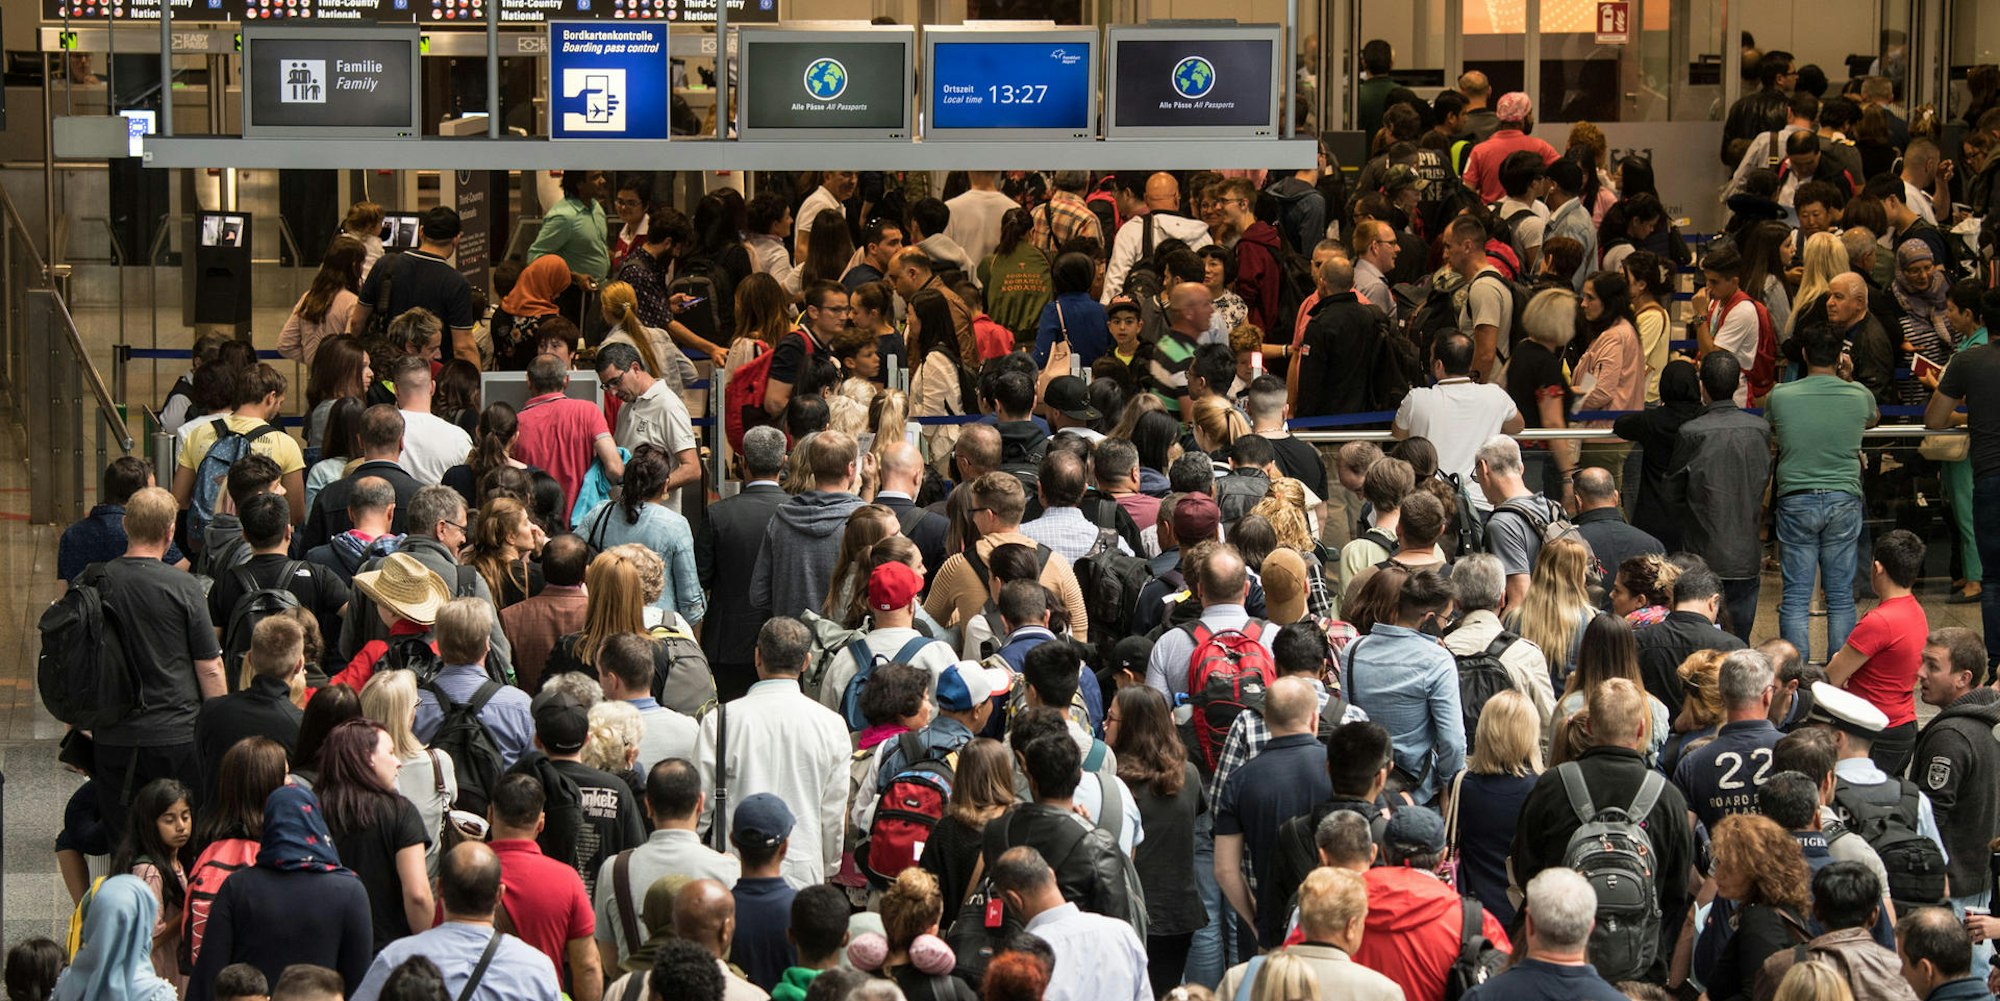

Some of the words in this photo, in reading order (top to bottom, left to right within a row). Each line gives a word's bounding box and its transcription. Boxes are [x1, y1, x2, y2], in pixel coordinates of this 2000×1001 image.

[501, 0, 563, 10] Third-Country
[501, 11, 545, 21] Nationals
[563, 30, 653, 41] Bordkartenkontrolle
[562, 42, 602, 55] Boarding
[603, 44, 626, 55] pass
[627, 42, 660, 53] control
[336, 60, 383, 73] Familie
[335, 77, 378, 92] Family
[943, 84, 974, 93] Ortszeit
[989, 84, 1048, 104] 13:27
[943, 95, 964, 104] Local
[965, 95, 983, 104] time
[791, 103, 805, 111] Alle
[826, 103, 837, 111] All
[837, 103, 867, 112] Passports
[1159, 101, 1172, 109] Alle
[1193, 101, 1203, 109] All
[1203, 101, 1235, 110] Passports
[1714, 748, 1774, 790] 22
